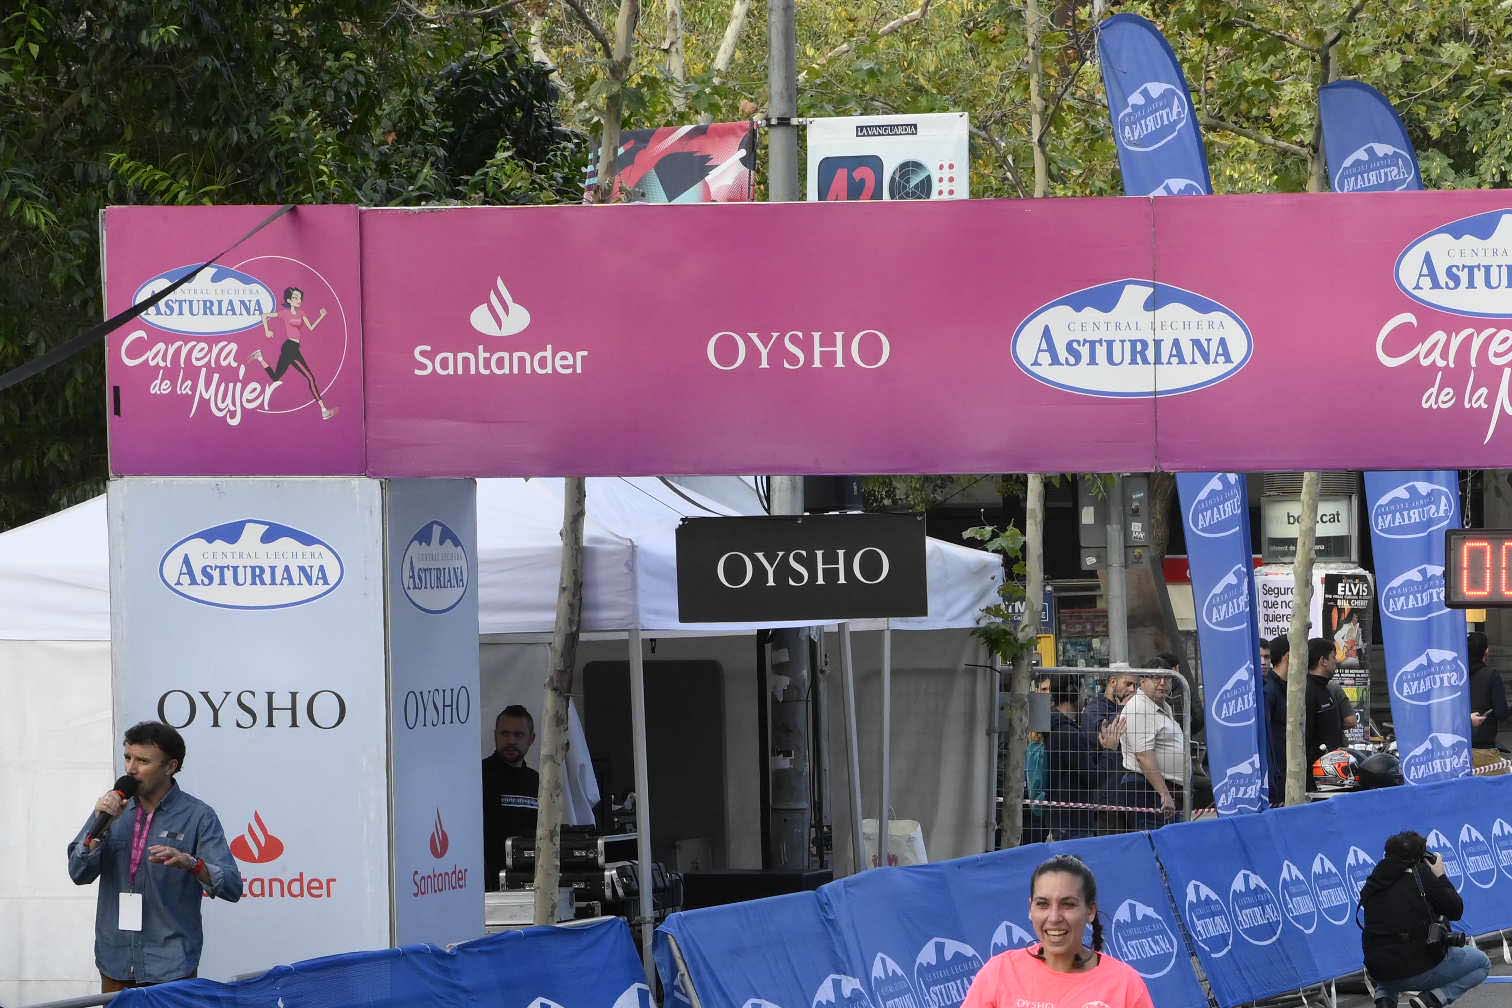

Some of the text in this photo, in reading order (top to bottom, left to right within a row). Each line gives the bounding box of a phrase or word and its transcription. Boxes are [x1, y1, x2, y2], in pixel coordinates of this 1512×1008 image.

[173, 287, 209, 296] ENTRAL
[1067, 319, 1226, 333] CENTRAL LECHERA
[121, 329, 238, 368] Carrera
[414, 344, 588, 376] Santander
[706, 330, 891, 371] OYSHO
[1030, 323, 1234, 368] ASTURIANA
[150, 363, 283, 427] de la Mujer
[1422, 372, 1457, 409] de
[1464, 371, 1489, 409] la
[174, 553, 330, 587] ASTURIANA
[202, 551, 324, 560] CENTRAL LECHERA
[407, 554, 465, 591] ASTURIANA
[717, 547, 890, 589] OYSHO
[1263, 600, 1279, 610] que
[1338, 583, 1368, 596] ELVIS
[156, 689, 347, 730] OYSHO
[404, 685, 471, 730] OYSHO
[240, 872, 337, 898] tander
[412, 865, 468, 898] Santander
